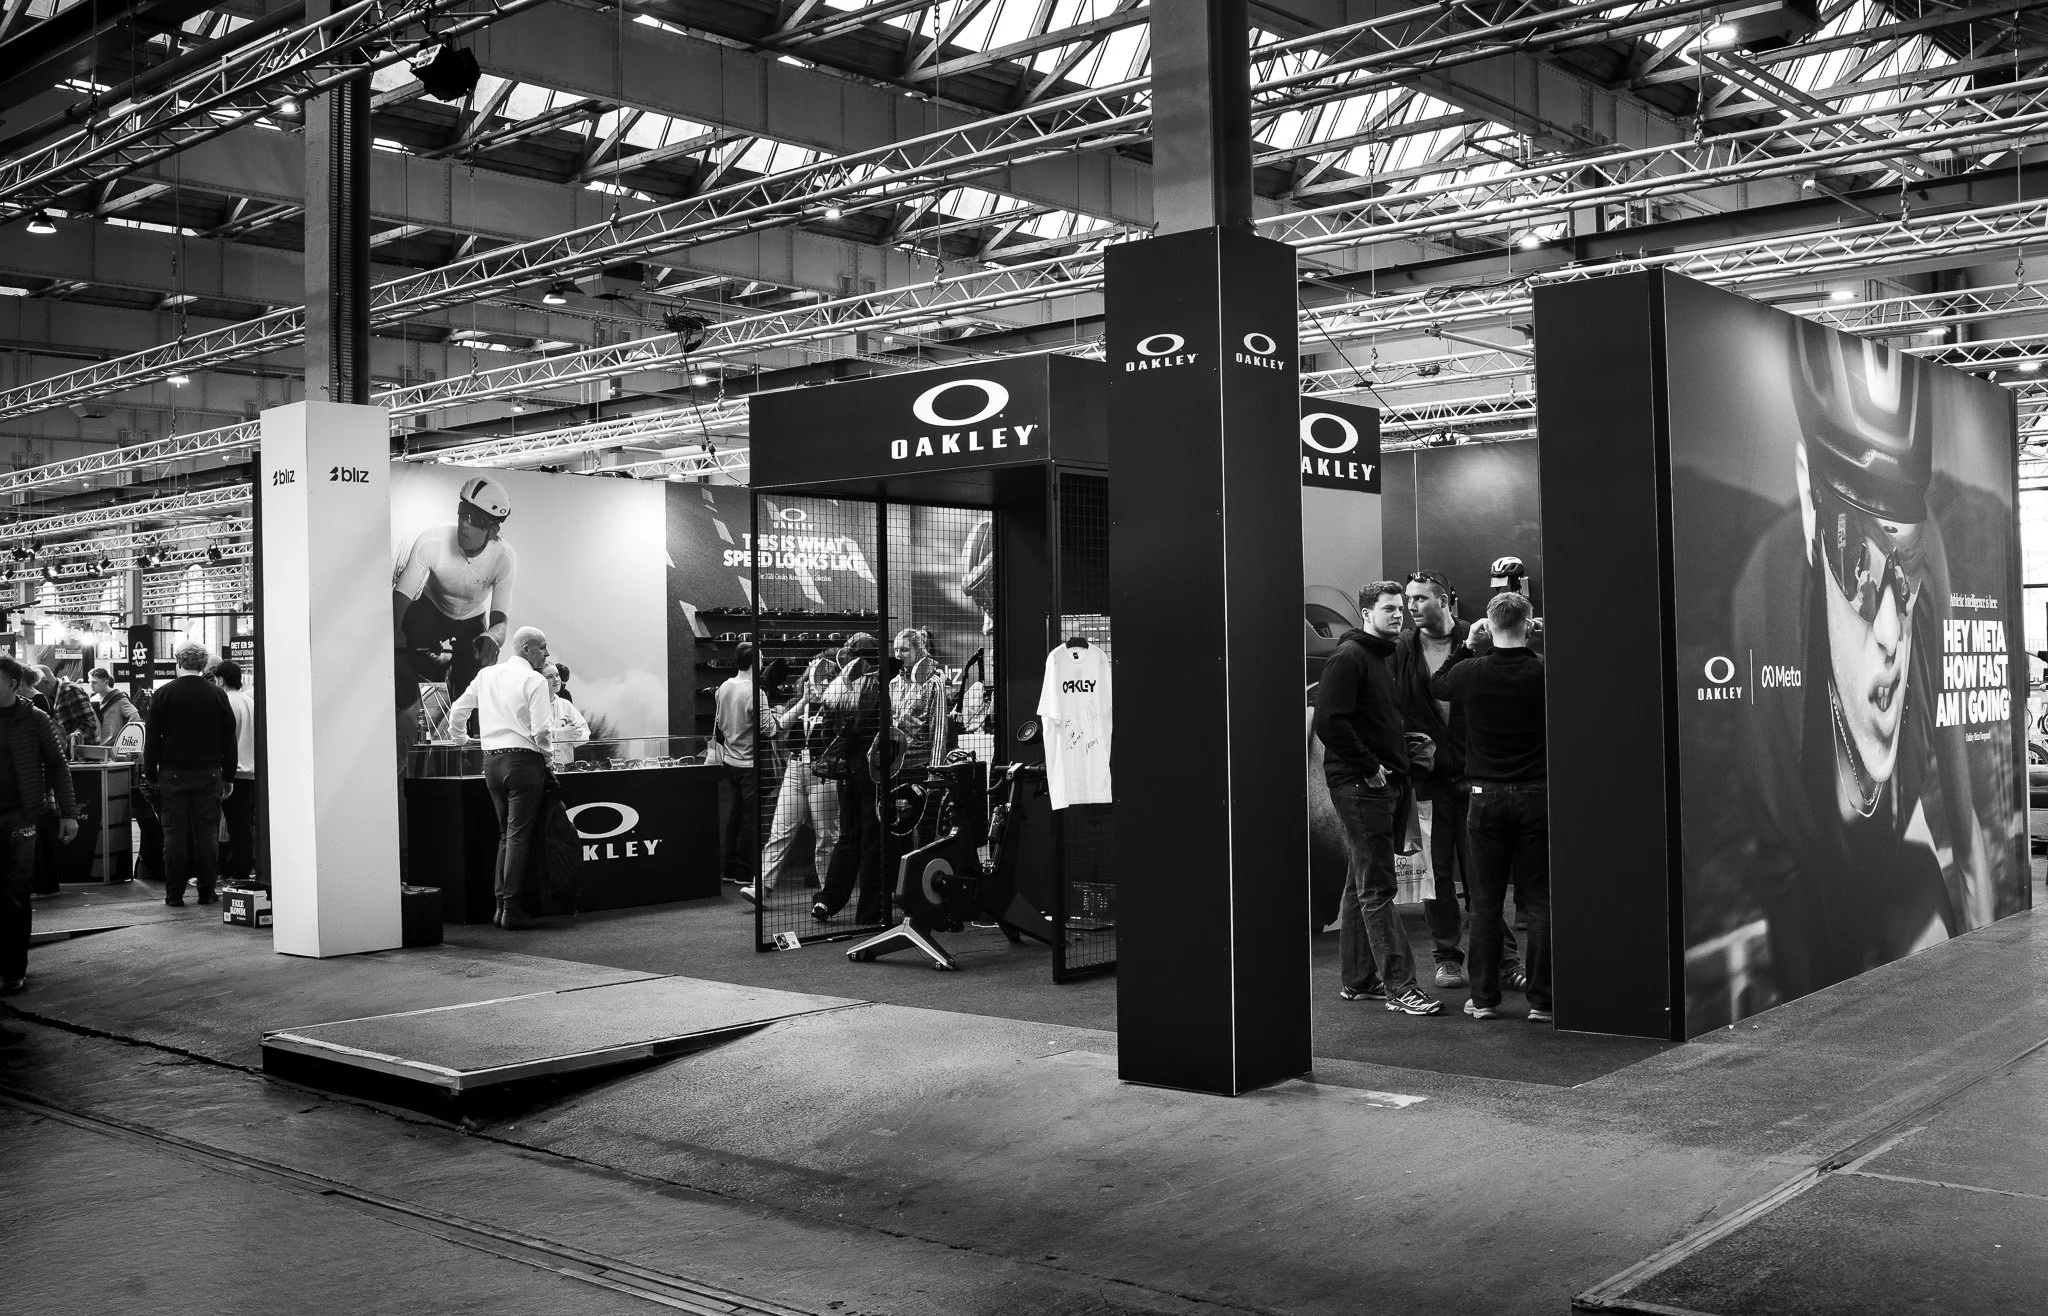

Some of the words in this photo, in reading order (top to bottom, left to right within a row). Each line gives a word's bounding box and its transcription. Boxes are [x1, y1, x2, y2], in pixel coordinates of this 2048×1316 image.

[1125, 353, 1197, 372] OAKLEY
[1236, 352, 1284, 371] OAKLEY
[891, 424, 1035, 460] OAKLEY
[279, 469, 295, 485] bliz
[341, 466, 369, 484] bliz
[1302, 456, 1373, 481] AKLEY
[774, 521, 814, 531] OAKLEY
[781, 535, 796, 552] IS
[797, 536, 844, 554] WHAT
[775, 552, 829, 571] LOOKS
[1943, 620, 1970, 653] HEY
[1972, 620, 2007, 653] META
[1943, 654, 1977, 690] HOW
[1979, 654, 2008, 688] FAST
[1063, 680, 1096, 693] OAKLEY
[1698, 687, 1742, 700] OAKLEY
[1776, 665, 1802, 687] Meta
[1936, 692, 1959, 727] AM
[1962, 692, 1967, 725] I
[122, 735, 138, 747] bike
[583, 839, 659, 861] KLEY
